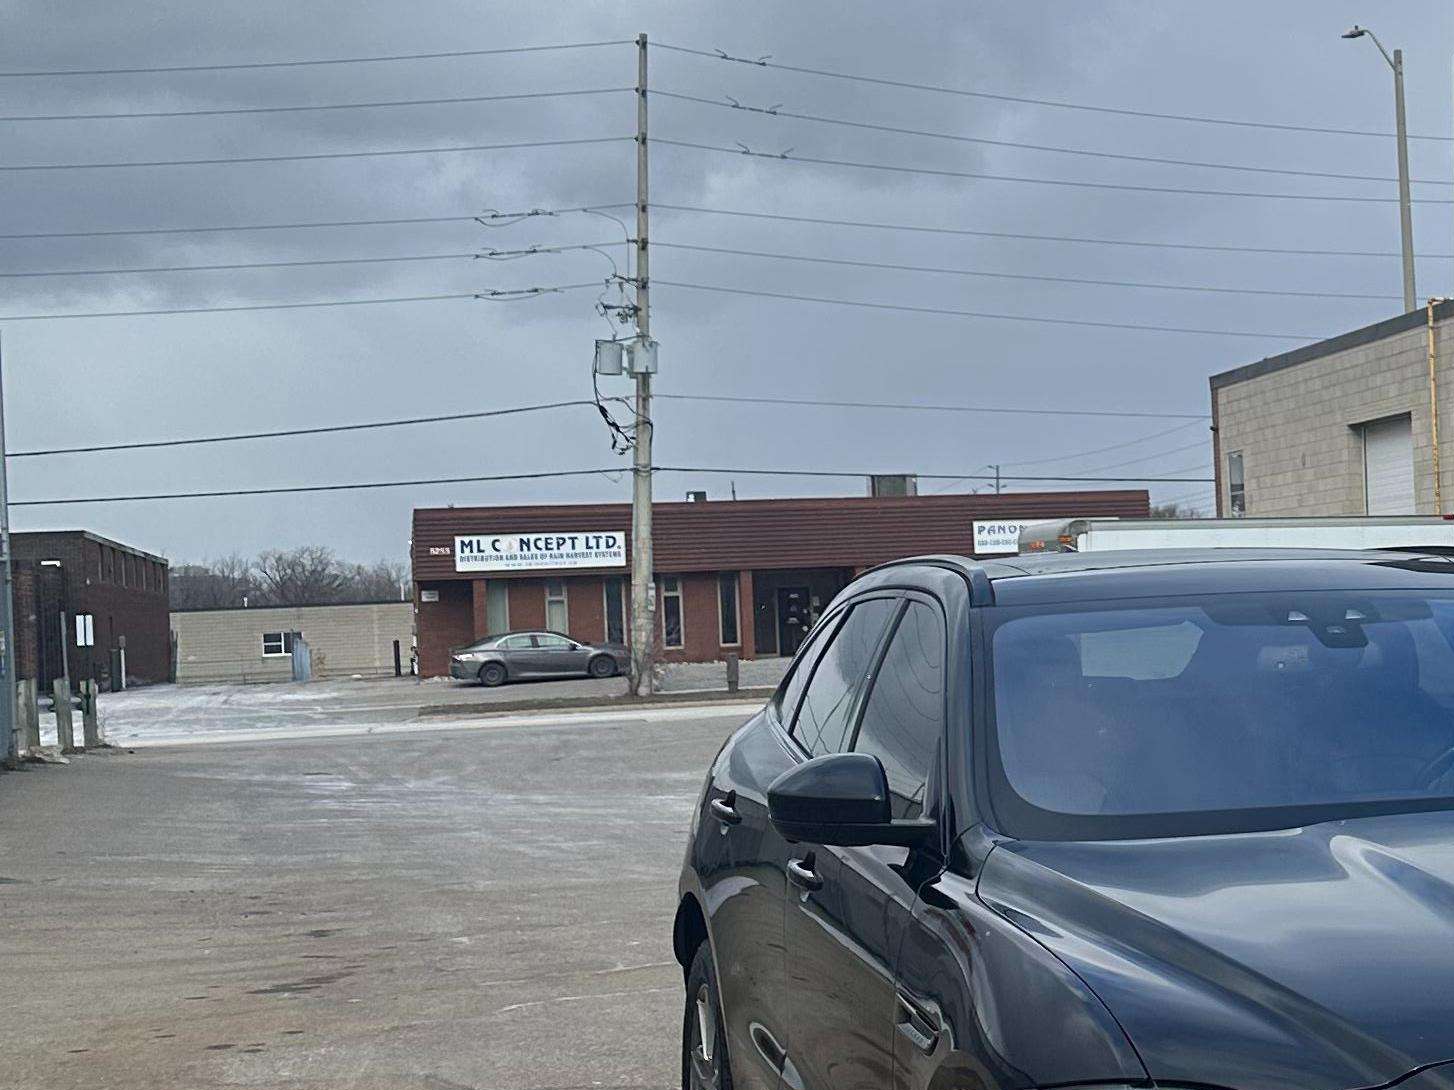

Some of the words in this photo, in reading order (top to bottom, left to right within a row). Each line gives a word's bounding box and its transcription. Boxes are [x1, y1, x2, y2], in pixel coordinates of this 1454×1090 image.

[460, 539, 485, 554] ML
[491, 536, 578, 552] CNCEPT
[585, 535, 621, 550] LTD.
